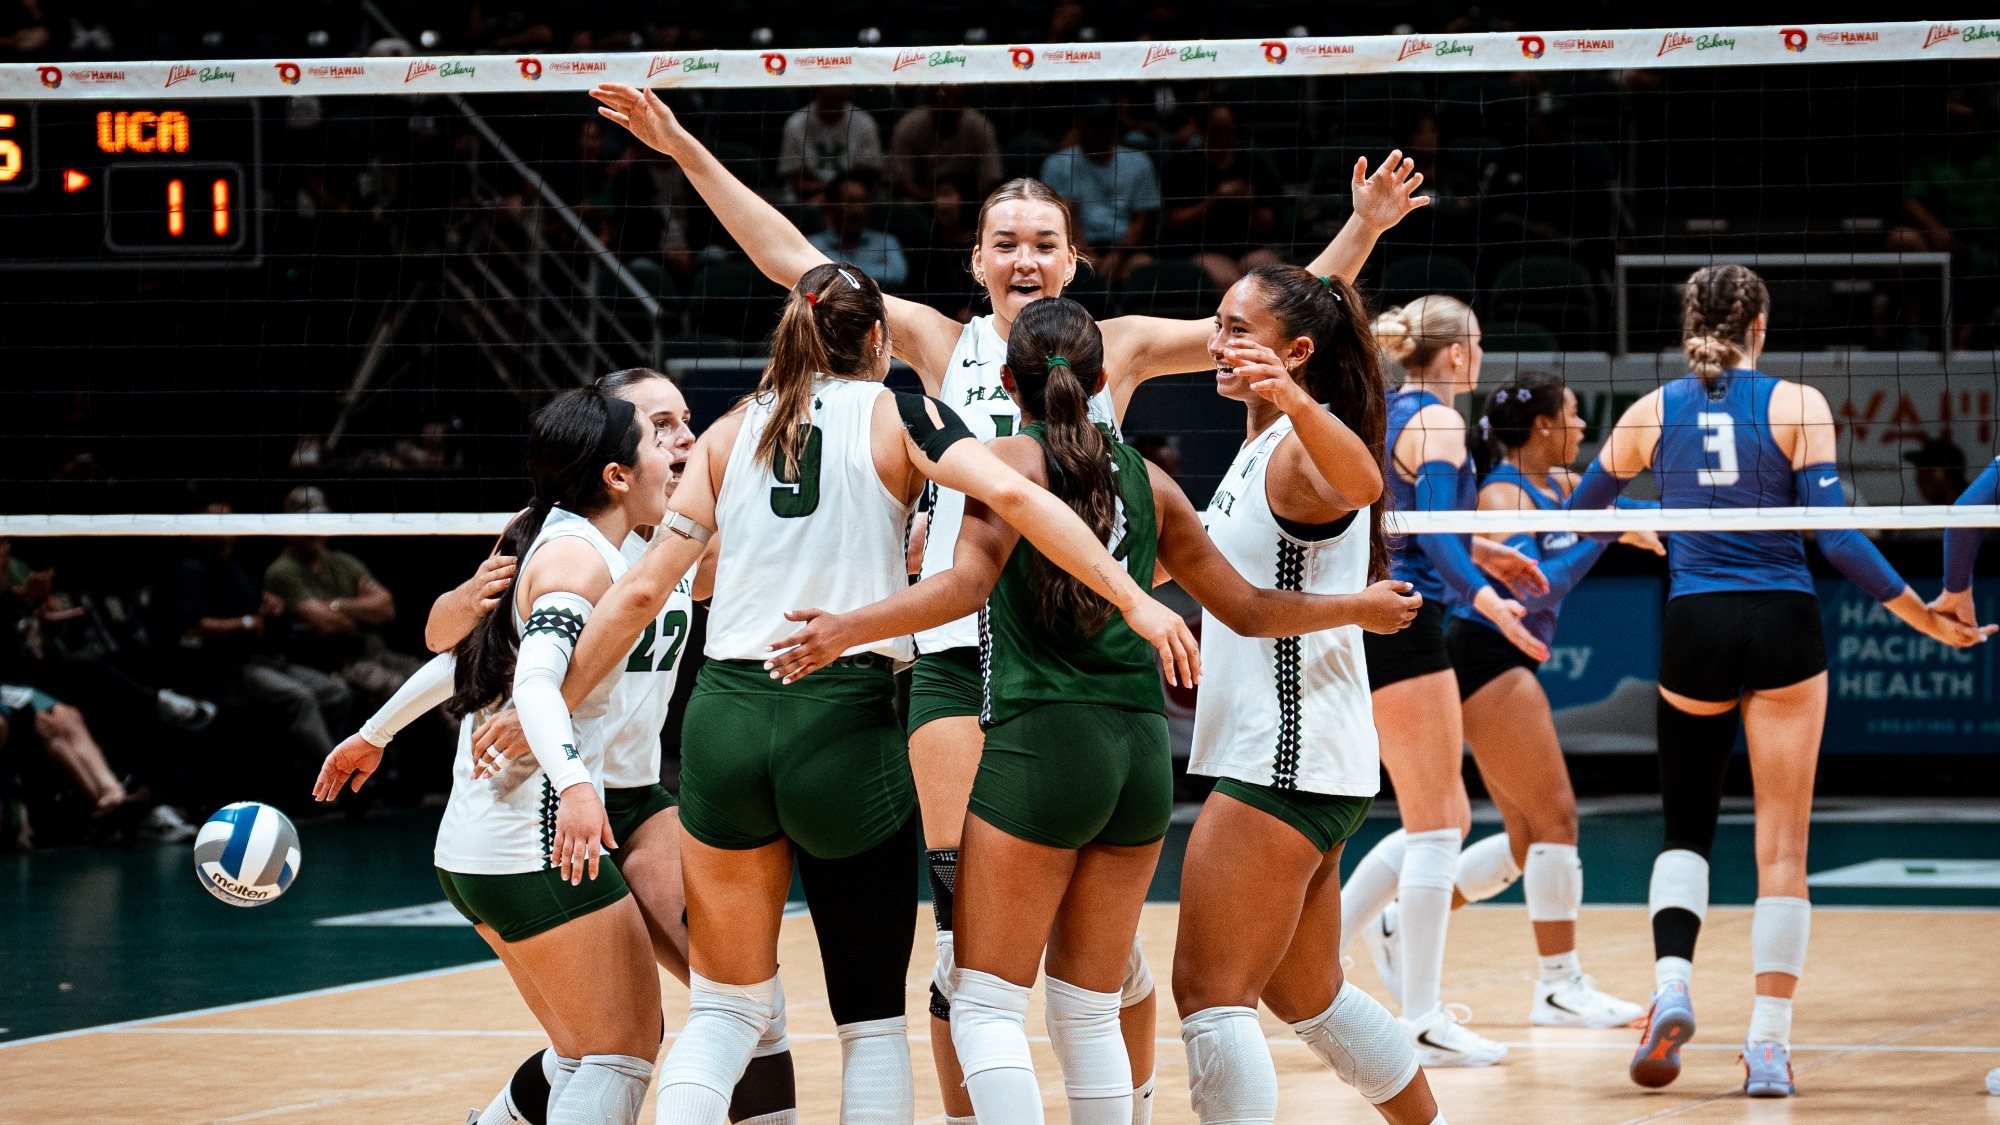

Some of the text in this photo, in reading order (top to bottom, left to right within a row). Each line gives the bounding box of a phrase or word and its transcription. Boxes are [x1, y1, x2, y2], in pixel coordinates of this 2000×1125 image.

[1695, 33, 1736, 50] Bakery
[1841, 32, 1878, 42] HAWAII
[1961, 25, 2000, 42] Bakery
[1318, 44, 1354, 54] HAWAII
[1435, 39, 1474, 57] Bakery
[1577, 39, 1614, 49] HAWAII
[817, 56, 852, 66] HAWAII
[928, 50, 966, 67] Bakery
[1065, 50, 1101, 60] HAWAII
[1179, 46, 1218, 62] Bakery
[330, 66, 364, 76] HAWAII
[438, 61, 475, 78] Bakery
[572, 62, 607, 71] HAWAII
[682, 57, 720, 73] Bakery
[91, 71, 125, 80] HAWAII
[199, 66, 235, 83] Bakery
[97, 111, 190, 152] UCA
[168, 179, 229, 237] 11
[1697, 411, 1740, 486] 3
[770, 423, 822, 518] 9
[625, 610, 688, 672] 22
[1839, 671, 1973, 697] HEALTH
[212, 872, 270, 899] molten
